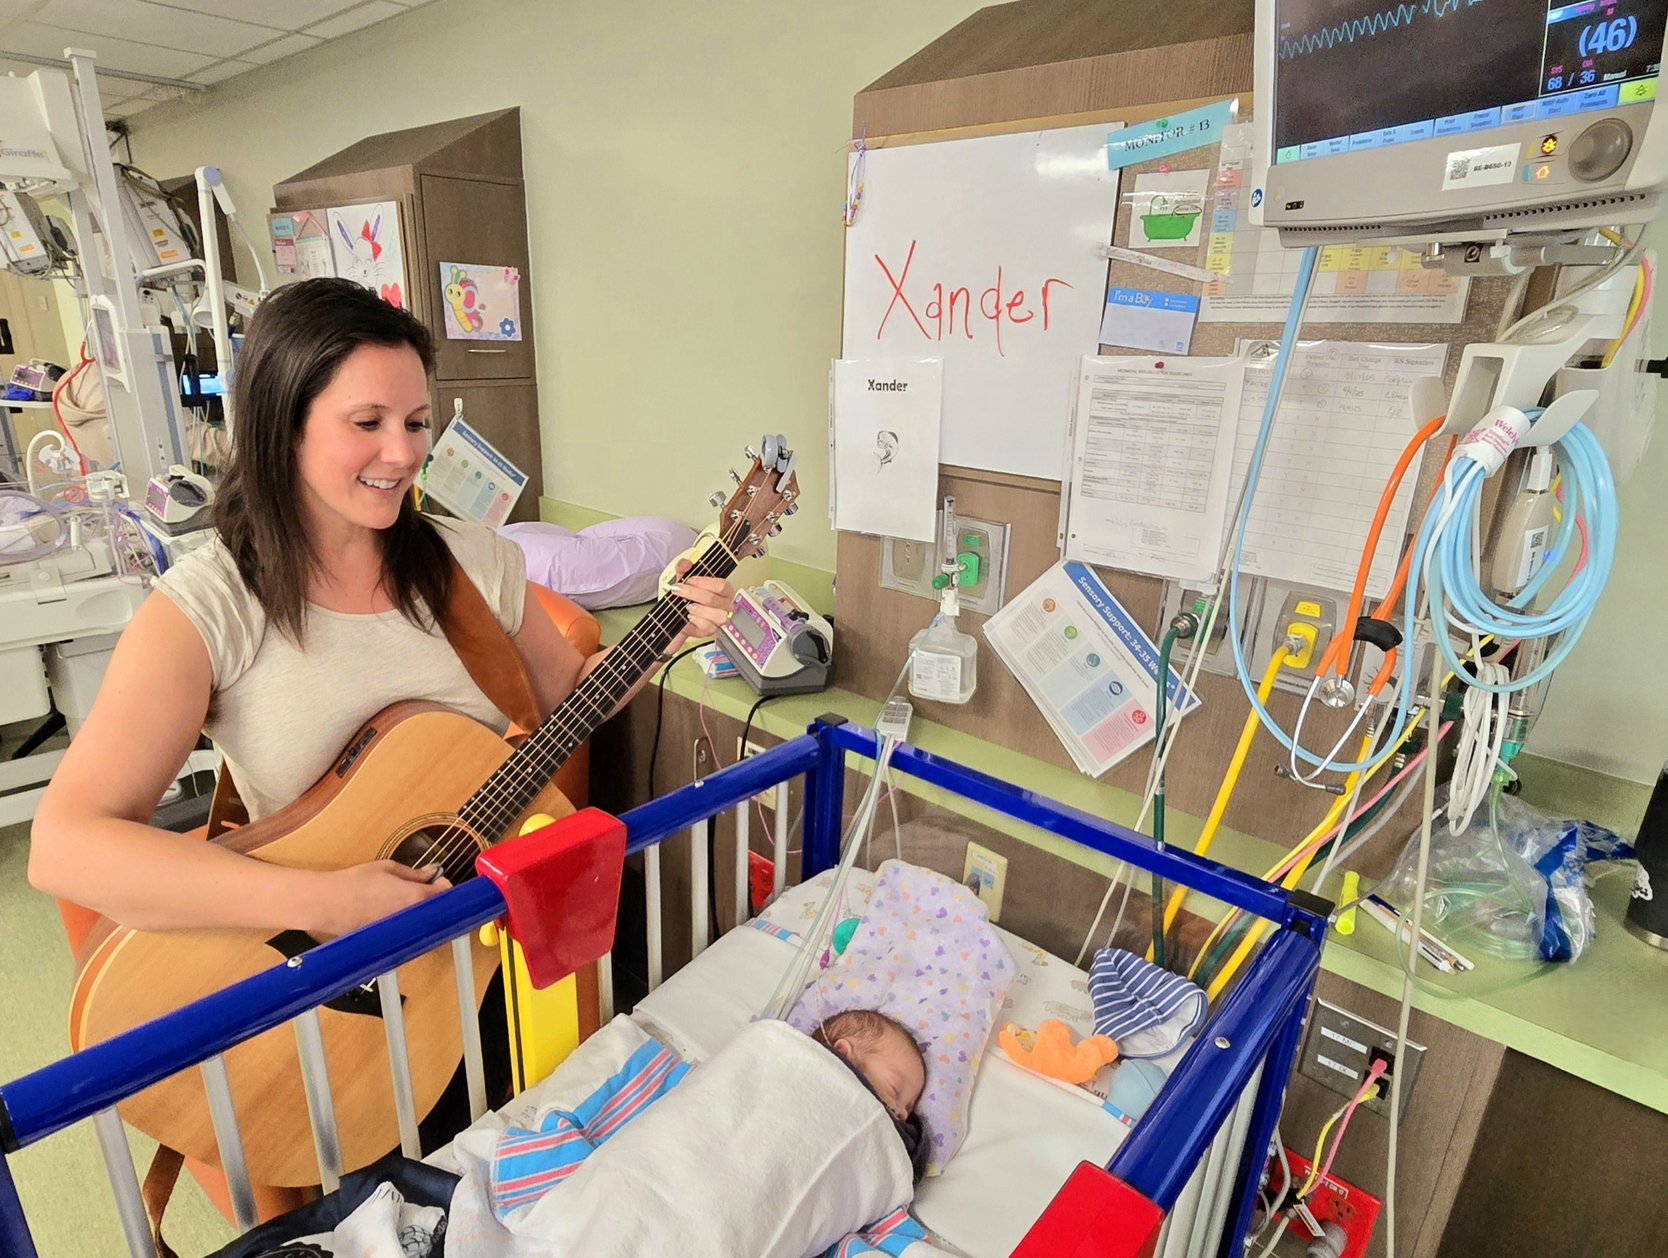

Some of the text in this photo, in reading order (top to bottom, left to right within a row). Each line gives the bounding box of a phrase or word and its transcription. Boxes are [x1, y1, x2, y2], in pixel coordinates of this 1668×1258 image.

[1579, 15, 1638, 57] (46)
[1547, 76, 1563, 91] 68
[1579, 70, 1596, 84] 36
[1124, 126, 1185, 152] MONITOR
[1199, 119, 1210, 131] 13
[1, 148, 43, 158] Giraffe
[874, 239, 1074, 358] Xander
[1135, 291, 1153, 308] Boy
[867, 378, 908, 393] Xander
[1077, 576, 1105, 609] Sensory
[1104, 606, 1131, 640] Support:
[1129, 638, 1151, 663] 34-35
